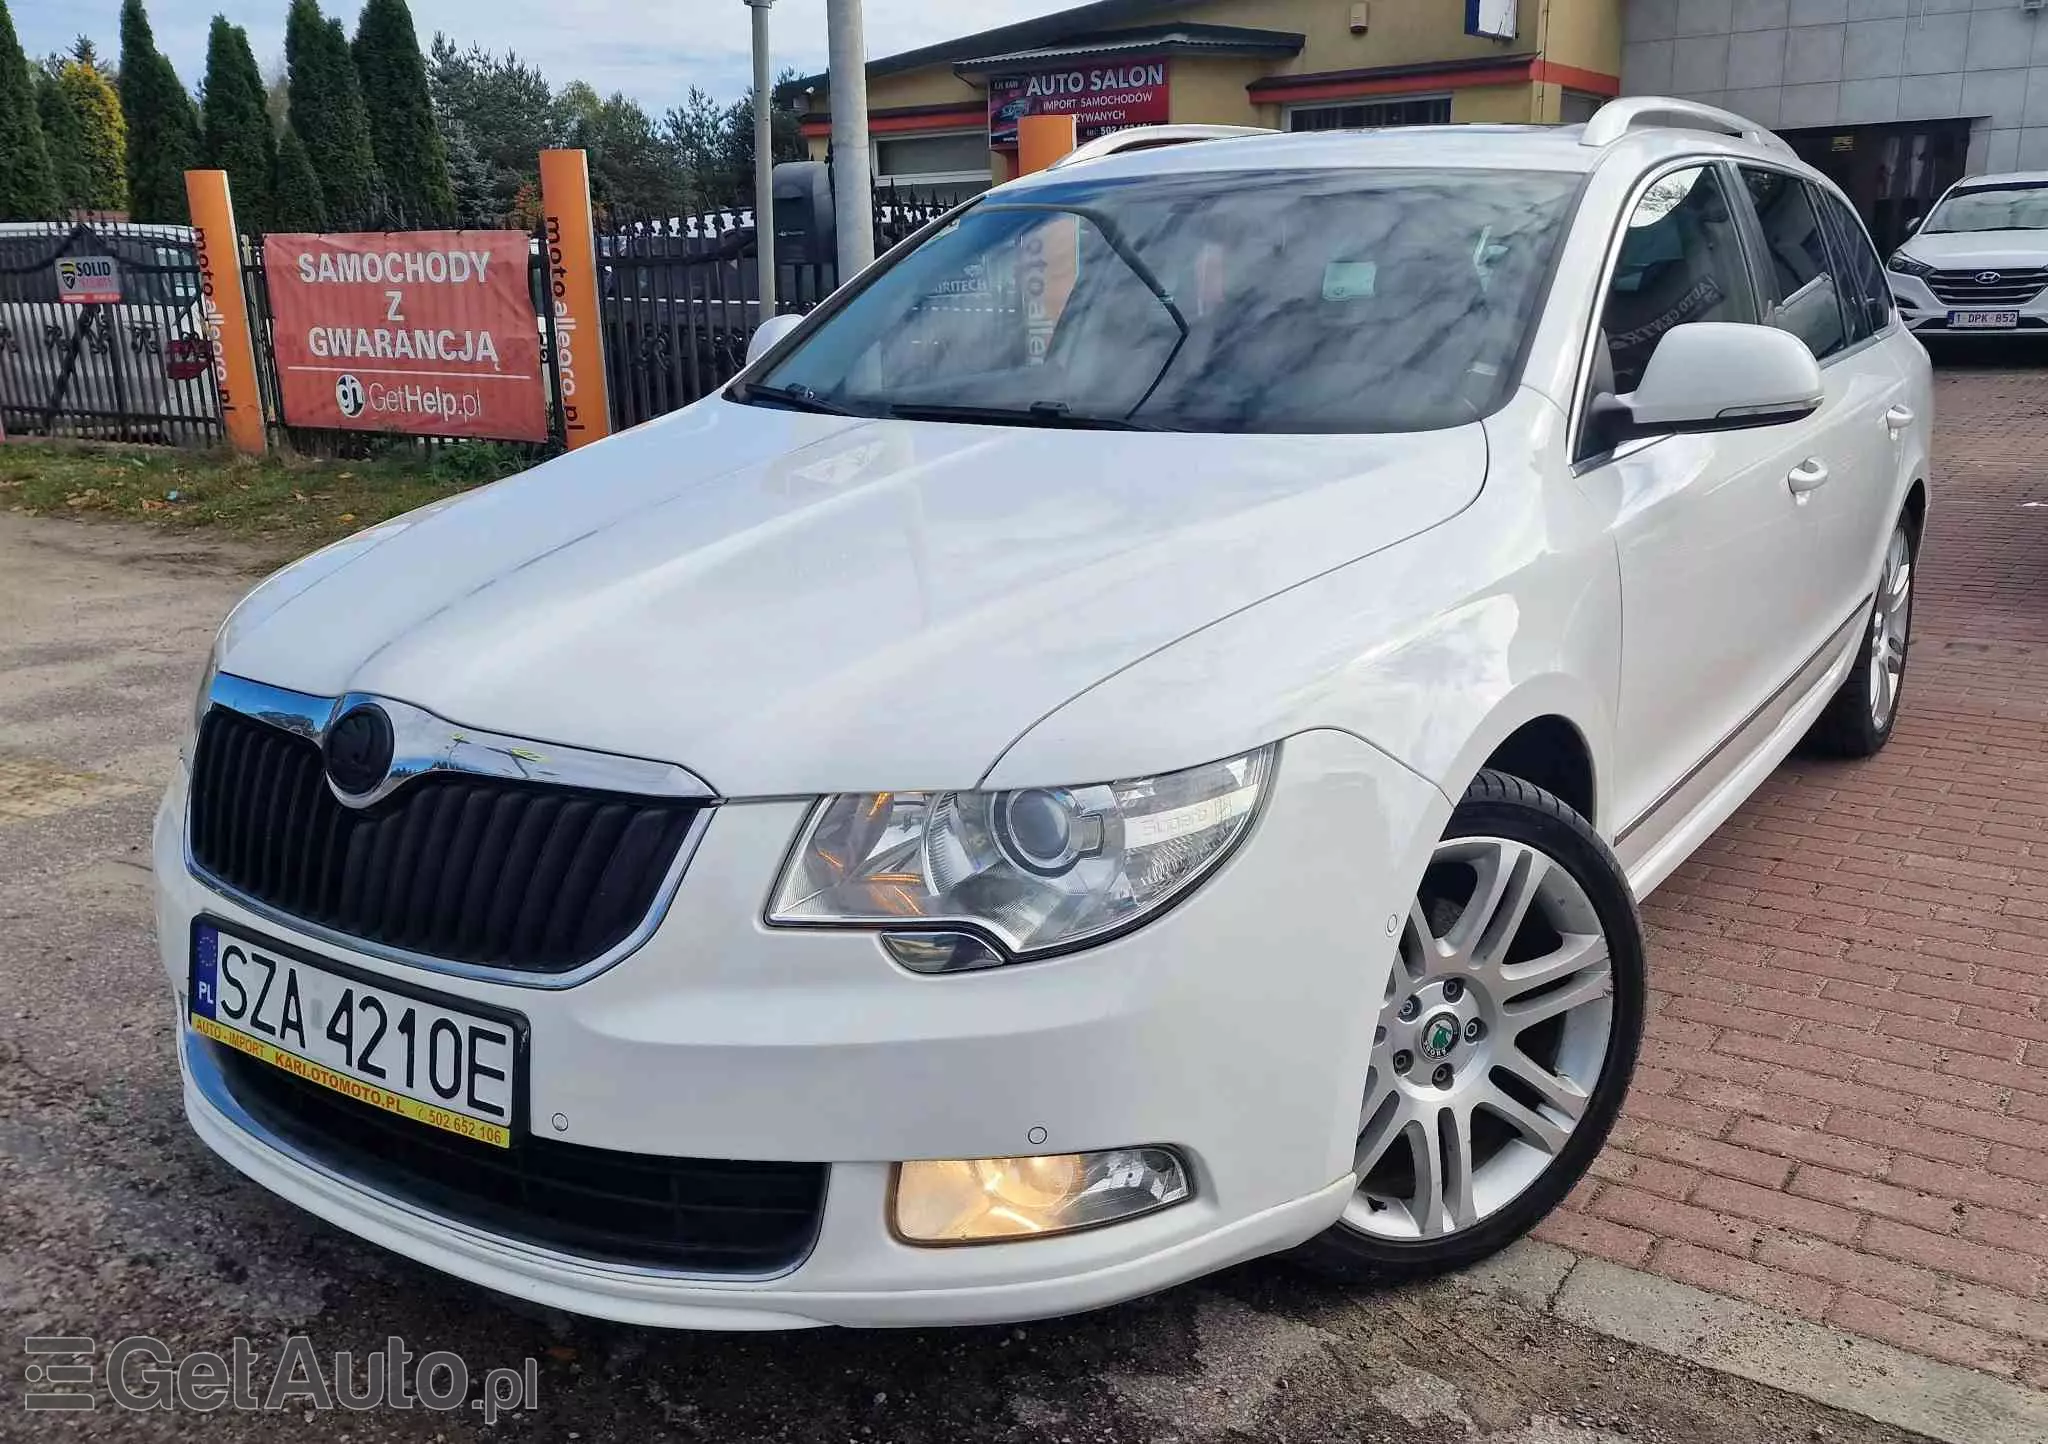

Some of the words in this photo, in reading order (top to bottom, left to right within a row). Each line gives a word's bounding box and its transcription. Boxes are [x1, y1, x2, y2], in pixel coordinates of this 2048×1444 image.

[1026, 72, 1084, 97] AUTO
[1089, 63, 1163, 91] SALON
[1043, 98, 1077, 111] IMPORT
[1075, 110, 1126, 123] ŻYWANYCH
[76, 262, 110, 277] SOLID
[299, 251, 491, 283] SAMOCHODY
[384, 290, 405, 321] Z
[308, 327, 501, 372] GWARANCJĄ
[368, 382, 482, 424] GetHelp.pl
[198, 980, 214, 1005] PL
[221, 944, 306, 1050] SZA
[326, 988, 507, 1118] 4210E
[196, 1019, 222, 1040] AUTO
[229, 1031, 266, 1057] IMPORT
[429, 1109, 450, 1129] 502
[454, 1116, 476, 1137] 652
[480, 1125, 502, 1145] 106
